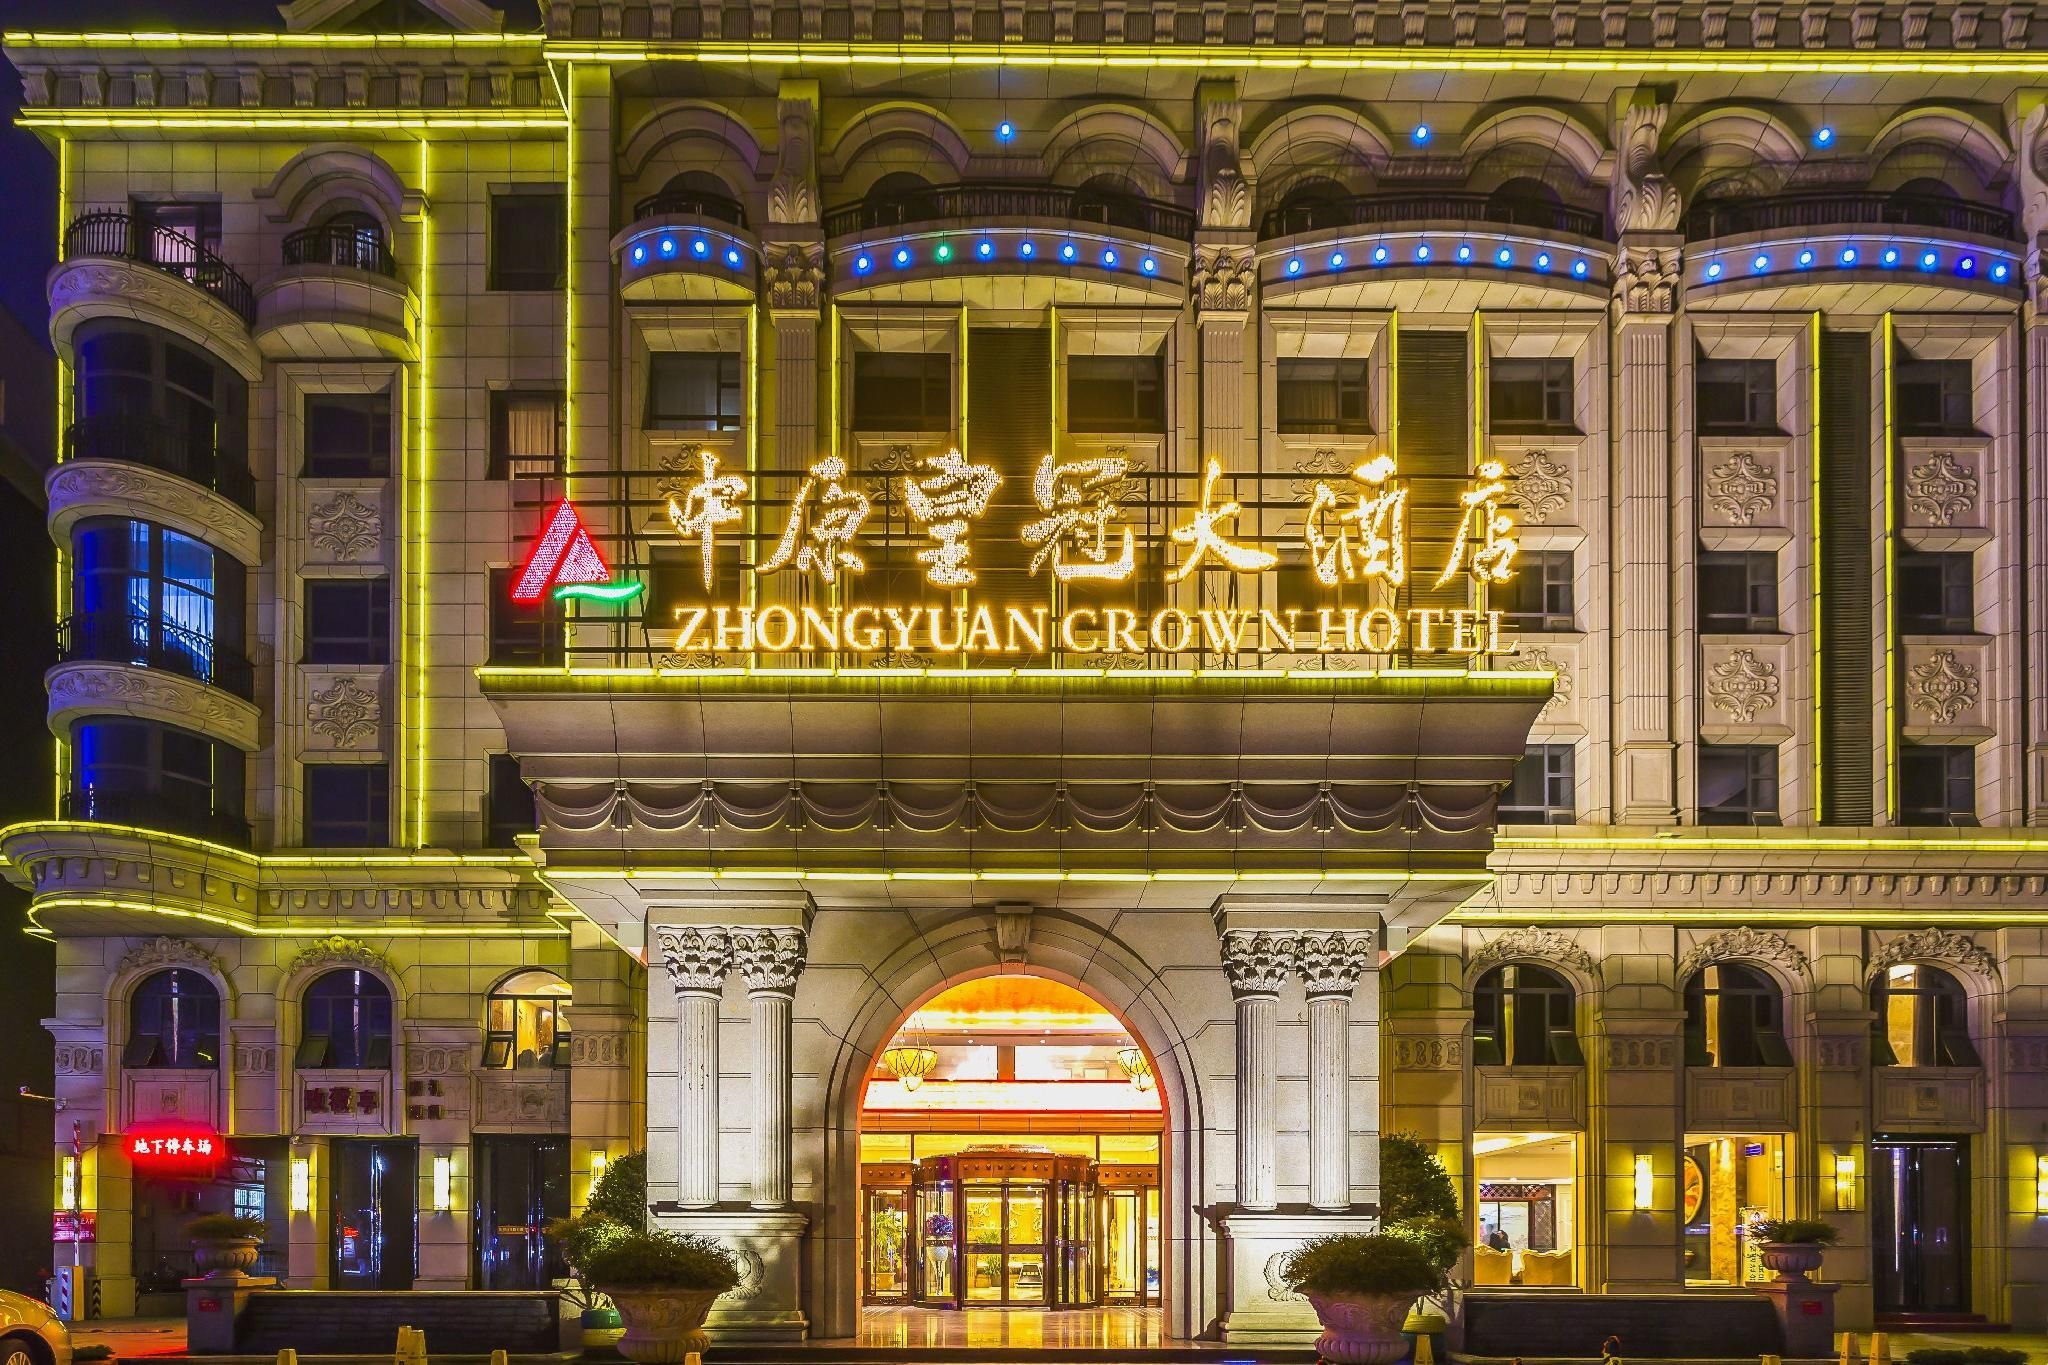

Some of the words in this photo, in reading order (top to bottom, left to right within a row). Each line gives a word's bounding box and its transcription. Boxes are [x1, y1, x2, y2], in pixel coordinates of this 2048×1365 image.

[668, 448, 1519, 592] 中原皇冠大酒店
[673, 606, 1048, 653] ZHONGYUAN
[1060, 607, 1301, 654] CROWN
[1316, 607, 1518, 654] HOTEL
[133, 1137, 212, 1156] 地下停车场
